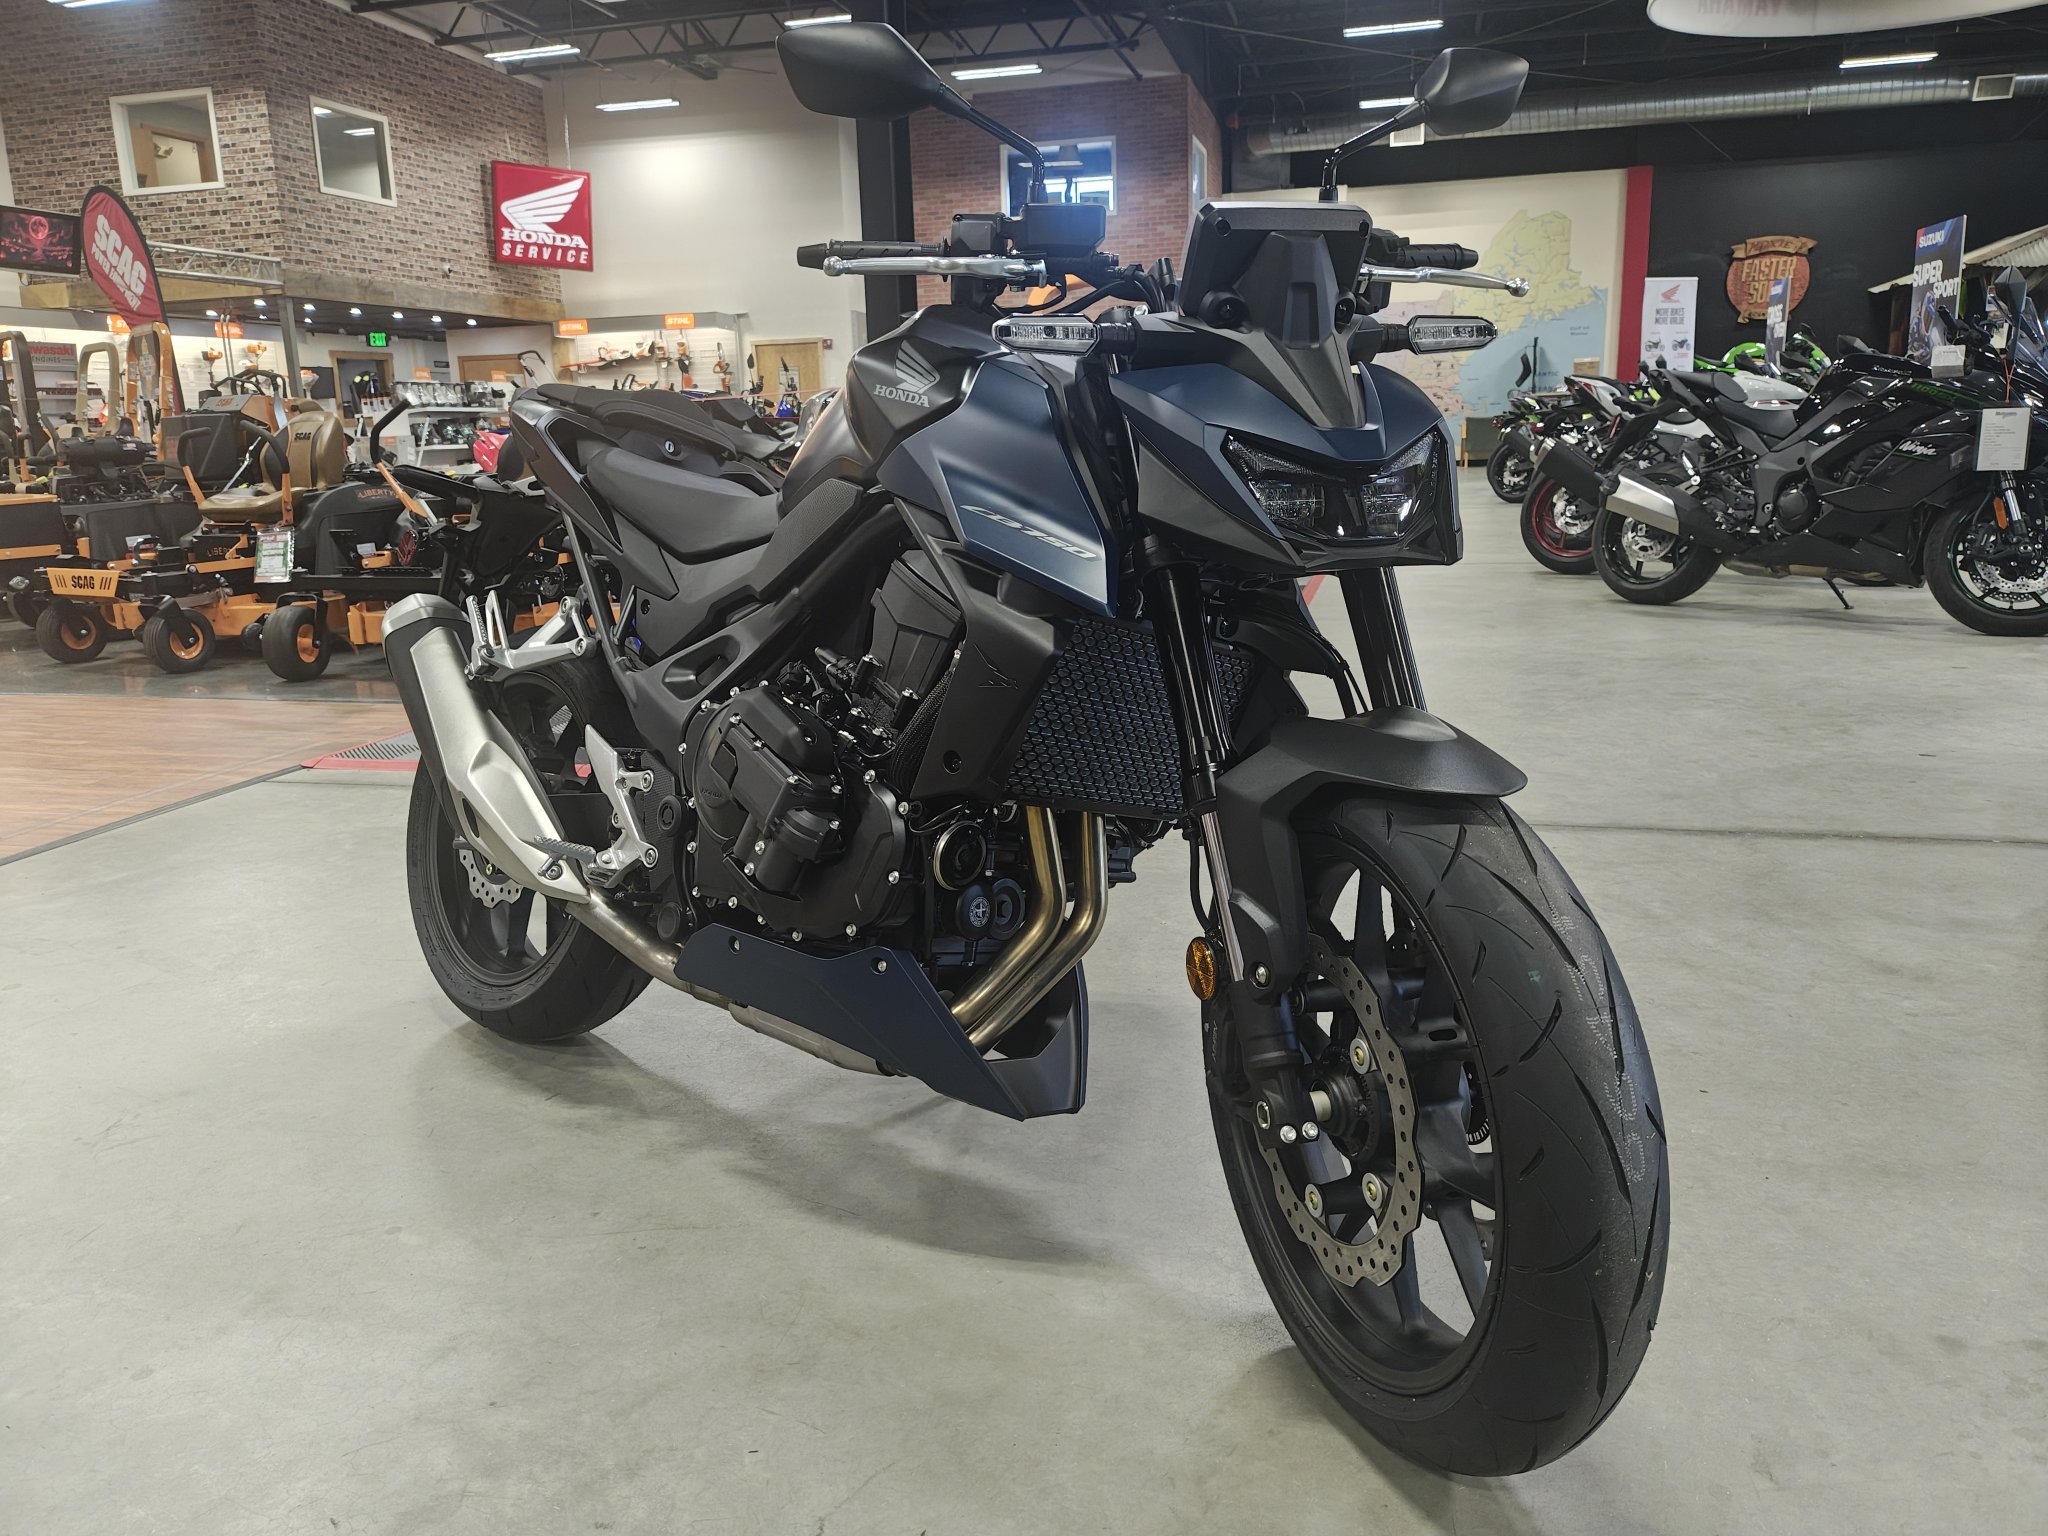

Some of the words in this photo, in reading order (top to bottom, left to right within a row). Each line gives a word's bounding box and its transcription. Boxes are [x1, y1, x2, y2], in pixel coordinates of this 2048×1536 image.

[501, 227, 589, 249] HONDA
[1919, 230, 1945, 248] SUZUKI
[91, 242, 111, 276] POWER
[94, 214, 147, 297] SCAG
[501, 242, 589, 264] SERVICE
[1741, 256, 1797, 282] FASTER
[1912, 259, 1944, 287] SUPER
[1748, 281, 1769, 304] SO
[1933, 277, 1960, 298] SPORT
[560, 323, 584, 331] STIHL
[667, 317, 691, 326] STIHL
[370, 332, 387, 347] EXIT
[873, 384, 930, 408] HONDA
[294, 432, 312, 441] SCAG
[1899, 440, 1937, 456] Ninja
[71, 575, 95, 590] SCAG
